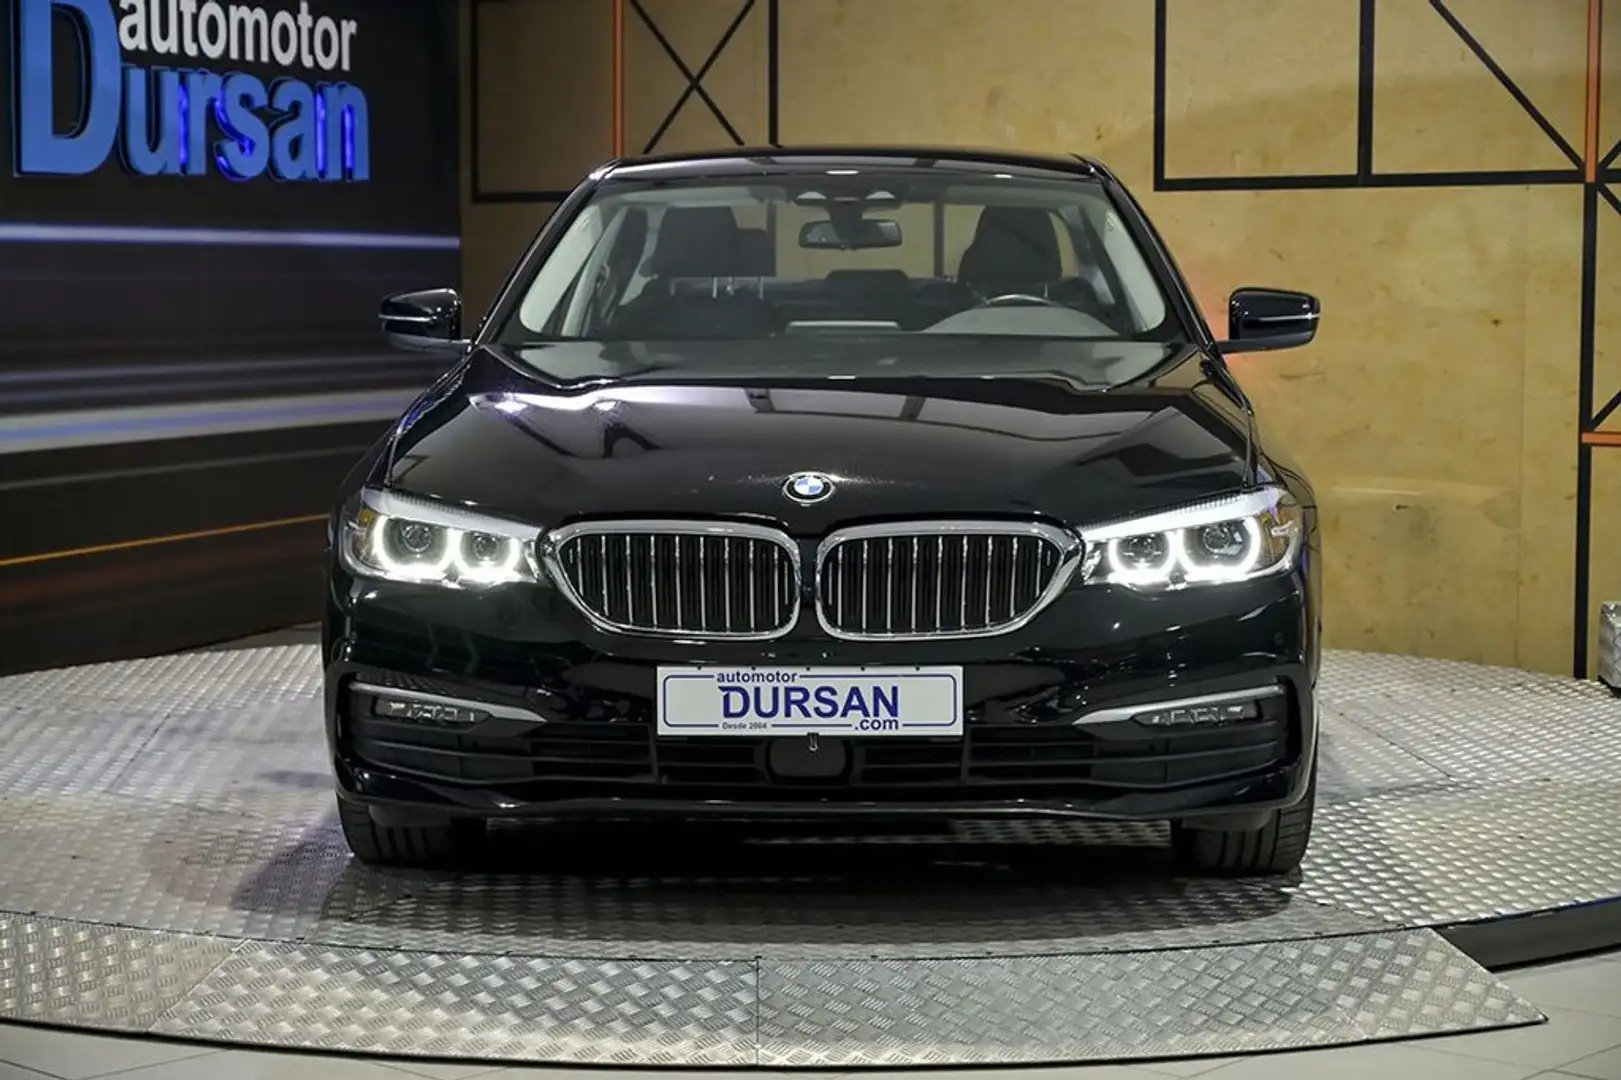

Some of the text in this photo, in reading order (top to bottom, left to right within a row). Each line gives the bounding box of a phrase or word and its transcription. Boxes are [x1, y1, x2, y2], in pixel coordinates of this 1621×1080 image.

[118, 0, 356, 71] automotor
[13, 0, 370, 182] Dursan
[717, 670, 797, 683] automotor
[718, 686, 898, 718] DURSAN
[722, 722, 747, 730] Desde
[855, 717, 899, 731] .com
